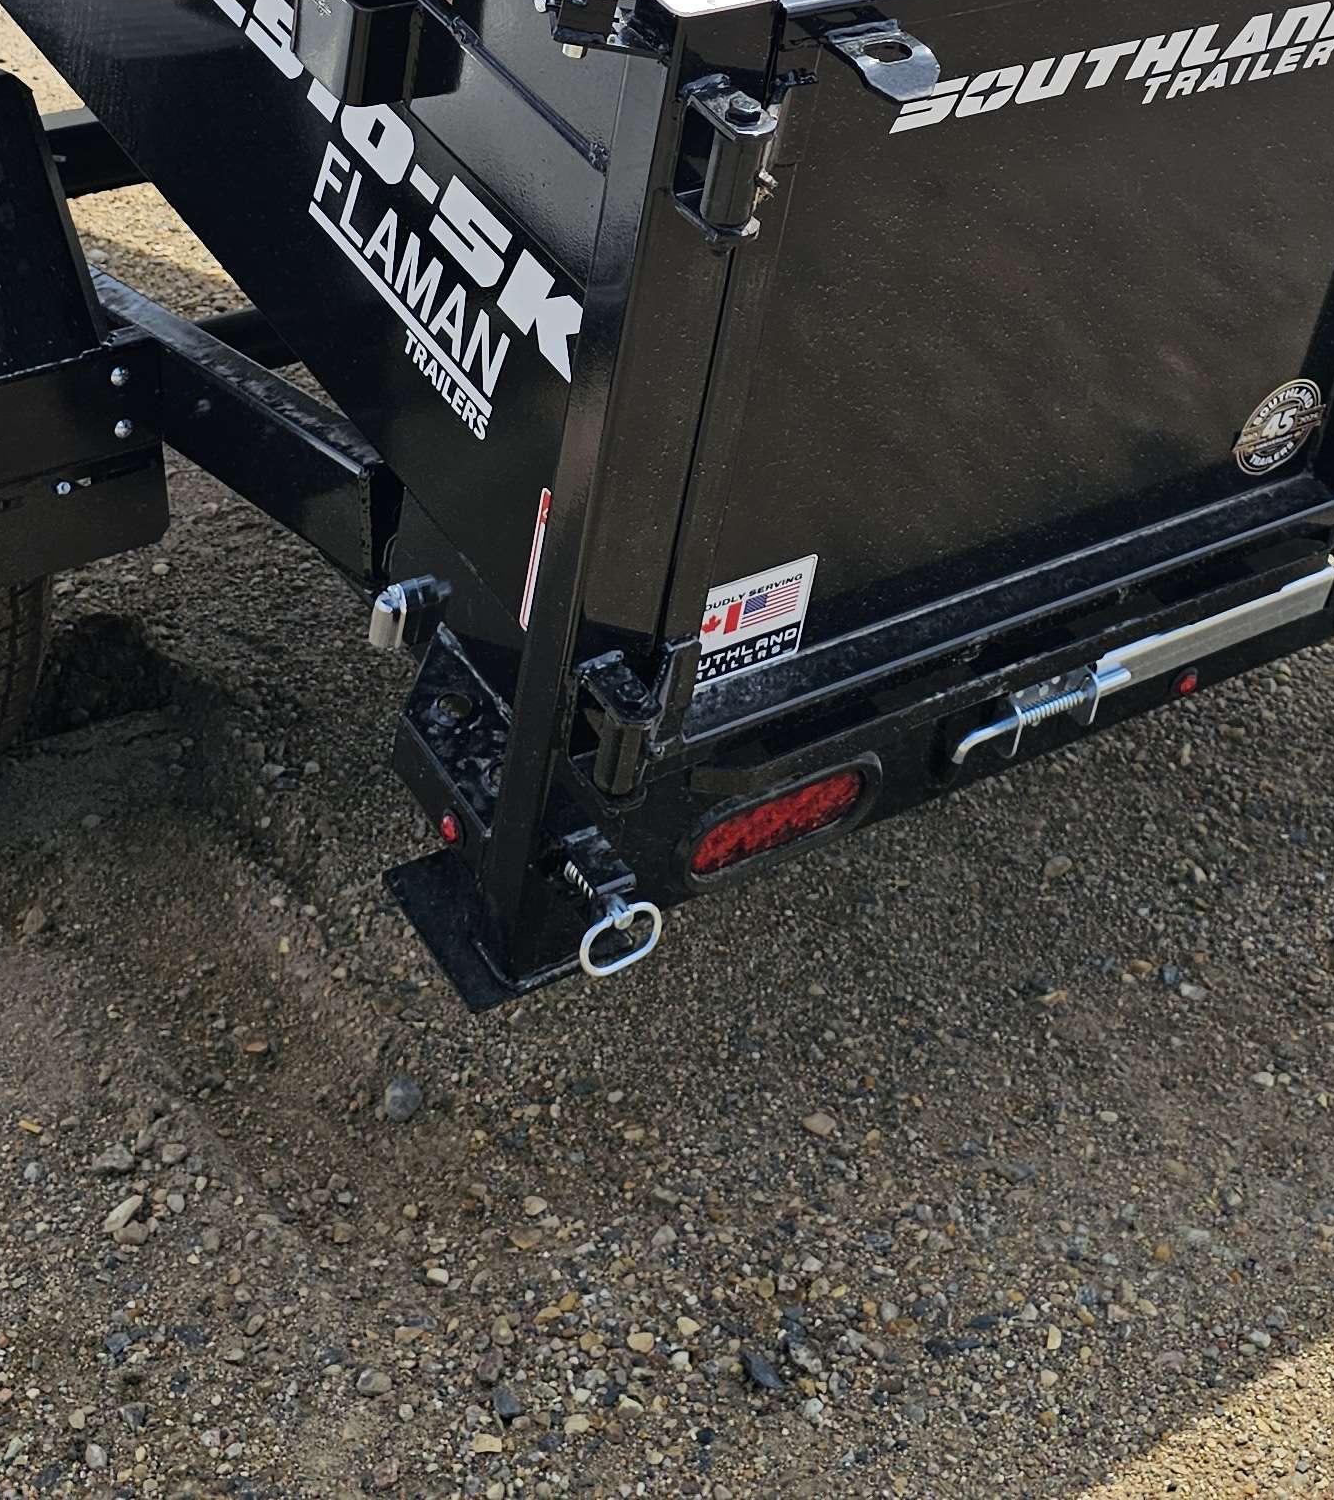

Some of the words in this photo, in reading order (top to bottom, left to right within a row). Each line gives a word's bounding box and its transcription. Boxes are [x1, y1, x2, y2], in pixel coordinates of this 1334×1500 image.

[314, 141, 510, 398] FLAMAN
[405, 328, 492, 441] TRAILERS
[1262, 407, 1298, 439] 45
[705, 593, 746, 611] OUDLY
[749, 573, 803, 597] SERVING
[695, 645, 781, 680] RAILERS
[697, 627, 798, 671] UTHLAND
